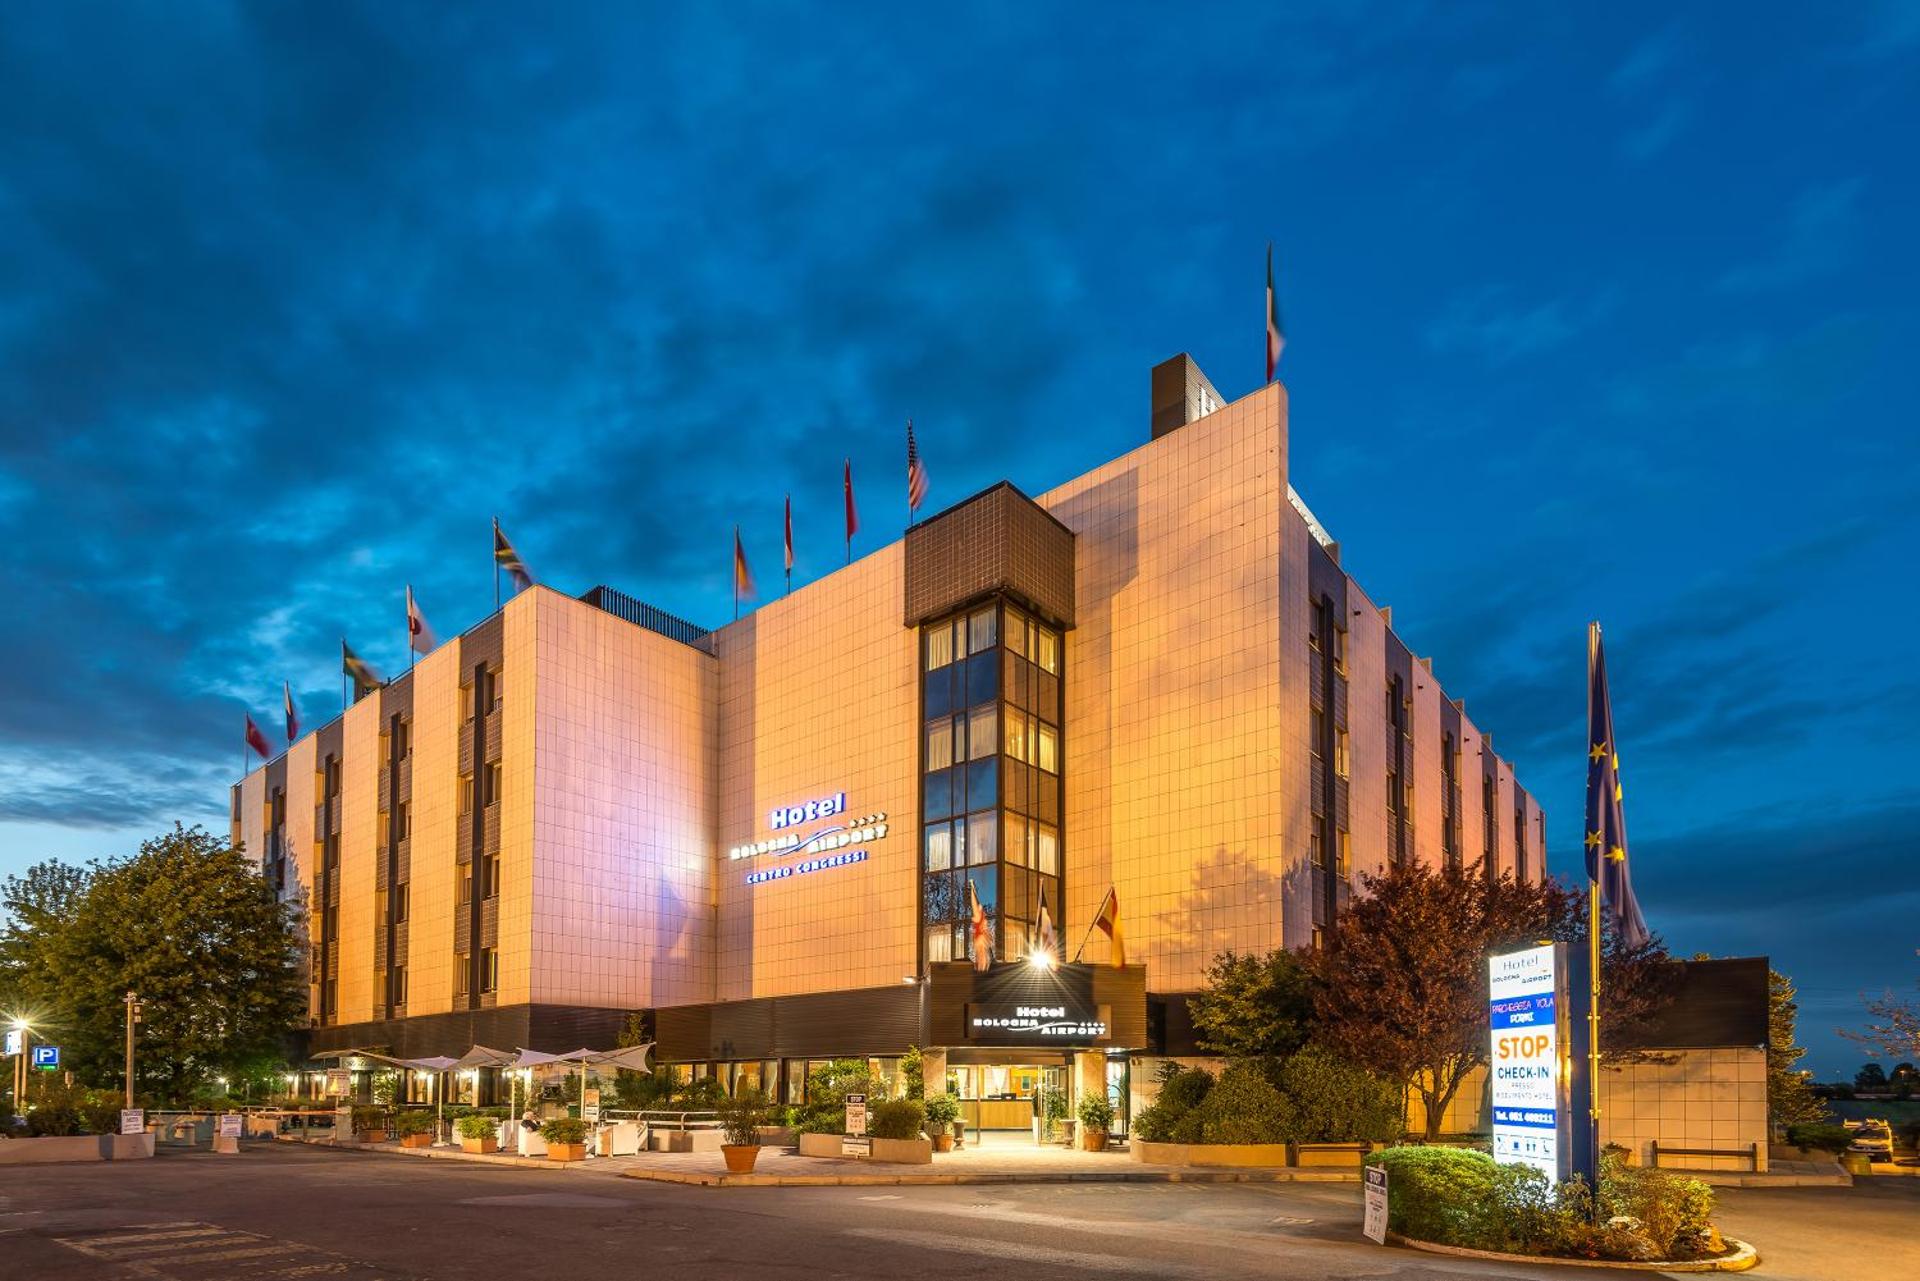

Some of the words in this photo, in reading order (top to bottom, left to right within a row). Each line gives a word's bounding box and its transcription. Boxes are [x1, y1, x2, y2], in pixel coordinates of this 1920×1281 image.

[771, 792, 845, 829] Hotel
[807, 824, 888, 854] AIRPORT
[746, 867, 793, 885] CENTRO
[796, 850, 868, 874] CONGRESSI
[1503, 954, 1538, 971] Hotel
[1016, 1006, 1065, 1018] Hotel
[973, 1018, 1039, 1027] BOLOGNA
[1041, 1026, 1106, 1035] AIRPORT
[39, 1049, 54, 1062] P
[1499, 1034, 1549, 1060] STOP
[1498, 1065, 1549, 1080] CHECK-IN
